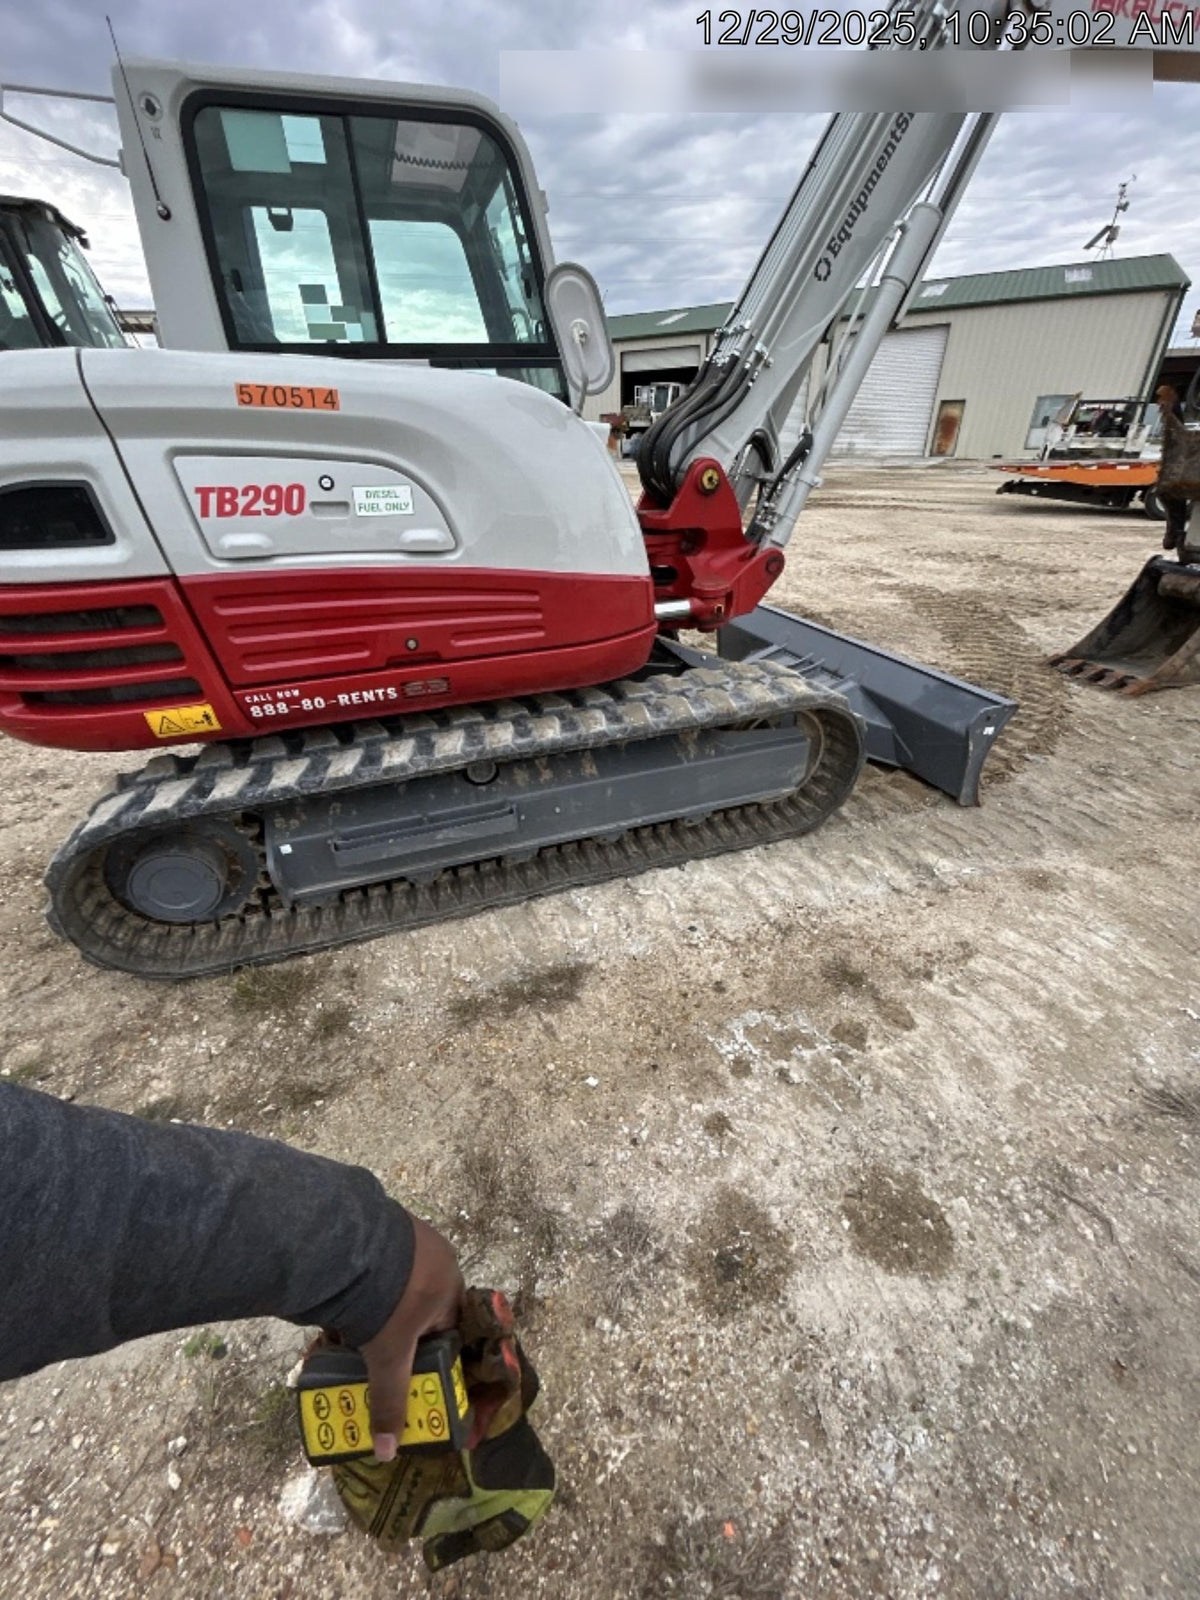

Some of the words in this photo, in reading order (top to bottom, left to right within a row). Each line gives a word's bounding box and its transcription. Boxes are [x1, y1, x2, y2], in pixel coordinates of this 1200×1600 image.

[238, 384, 337, 409] 570514
[194, 483, 306, 518] TB290
[365, 490, 400, 499] DIESEL
[358, 502, 383, 512] FUEL
[385, 502, 410, 512] ONLY
[245, 694, 272, 704] CALL
[276, 689, 300, 699] NOW
[250, 687, 398, 718] 888-80-RENTS
